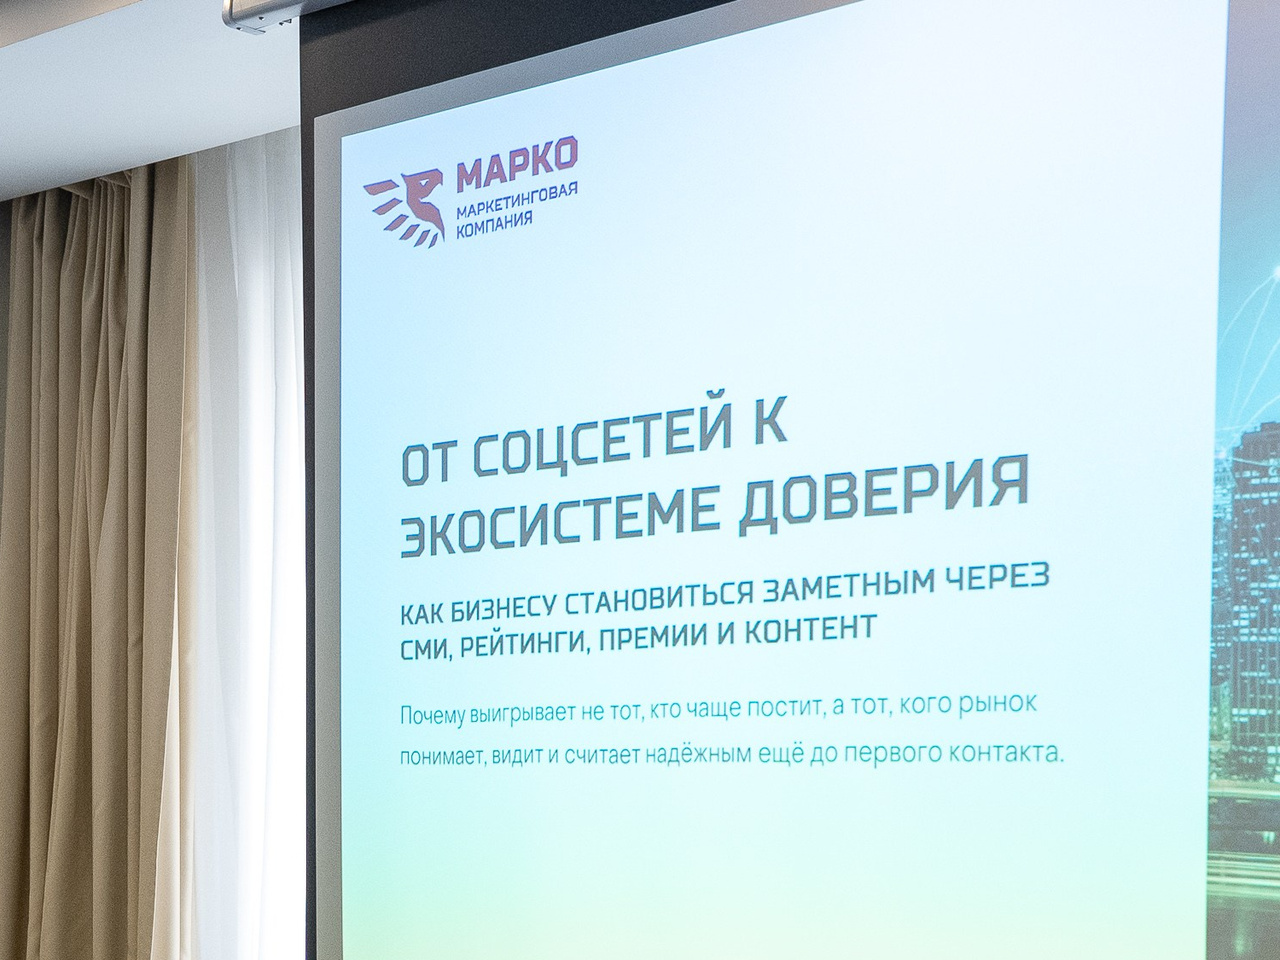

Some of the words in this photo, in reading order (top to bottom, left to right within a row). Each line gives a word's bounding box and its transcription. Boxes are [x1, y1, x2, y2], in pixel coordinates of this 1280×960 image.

[457, 135, 578, 194] МАРКО
[456, 180, 578, 220] МАРКЕТИНГОВАЯ
[456, 210, 533, 239] КОМПАНИЯ
[402, 439, 458, 487] ОТ
[473, 387, 732, 478] СОЦСЕТЕЙ
[754, 395, 788, 446] К
[400, 484, 721, 559] ЭКОСИСТЕМЕ
[738, 453, 1029, 539] ДОВЕРИЯ
[401, 602, 444, 626] КАК
[451, 593, 558, 623] БИЗНЕСУ
[564, 579, 754, 615] СТАНОВИТЬСЯ
[762, 567, 935, 604] ЗАМЕТНЫМ
[945, 560, 1050, 592] ЧЕРЕЗ
[400, 638, 453, 662] СМИ,
[460, 626, 591, 658] РЕЙТИНГИ,
[599, 622, 708, 652] ПРЕМИИ
[717, 620, 735, 646] И
[745, 613, 878, 644] КОНТЕНТ
[401, 705, 466, 730] Почему
[470, 705, 577, 728] выигрывает
[581, 704, 605, 721] не
[609, 704, 645, 723] тот,
[650, 702, 682, 719] кто
[686, 700, 742, 721] чаще
[747, 698, 827, 719] постит,
[832, 697, 844, 715] а
[851, 697, 893, 718] тот,
[900, 695, 952, 714] кого
[959, 693, 1038, 720] рынок
[400, 749, 487, 767] понимает,
[492, 748, 544, 768] видит
[548, 748, 559, 763] и
[564, 748, 641, 765] считает
[646, 741, 752, 767] надёжным
[758, 740, 805, 767] ещё
[809, 745, 838, 767] до
[844, 744, 943, 769] первого
[949, 744, 1064, 763] контакта.
